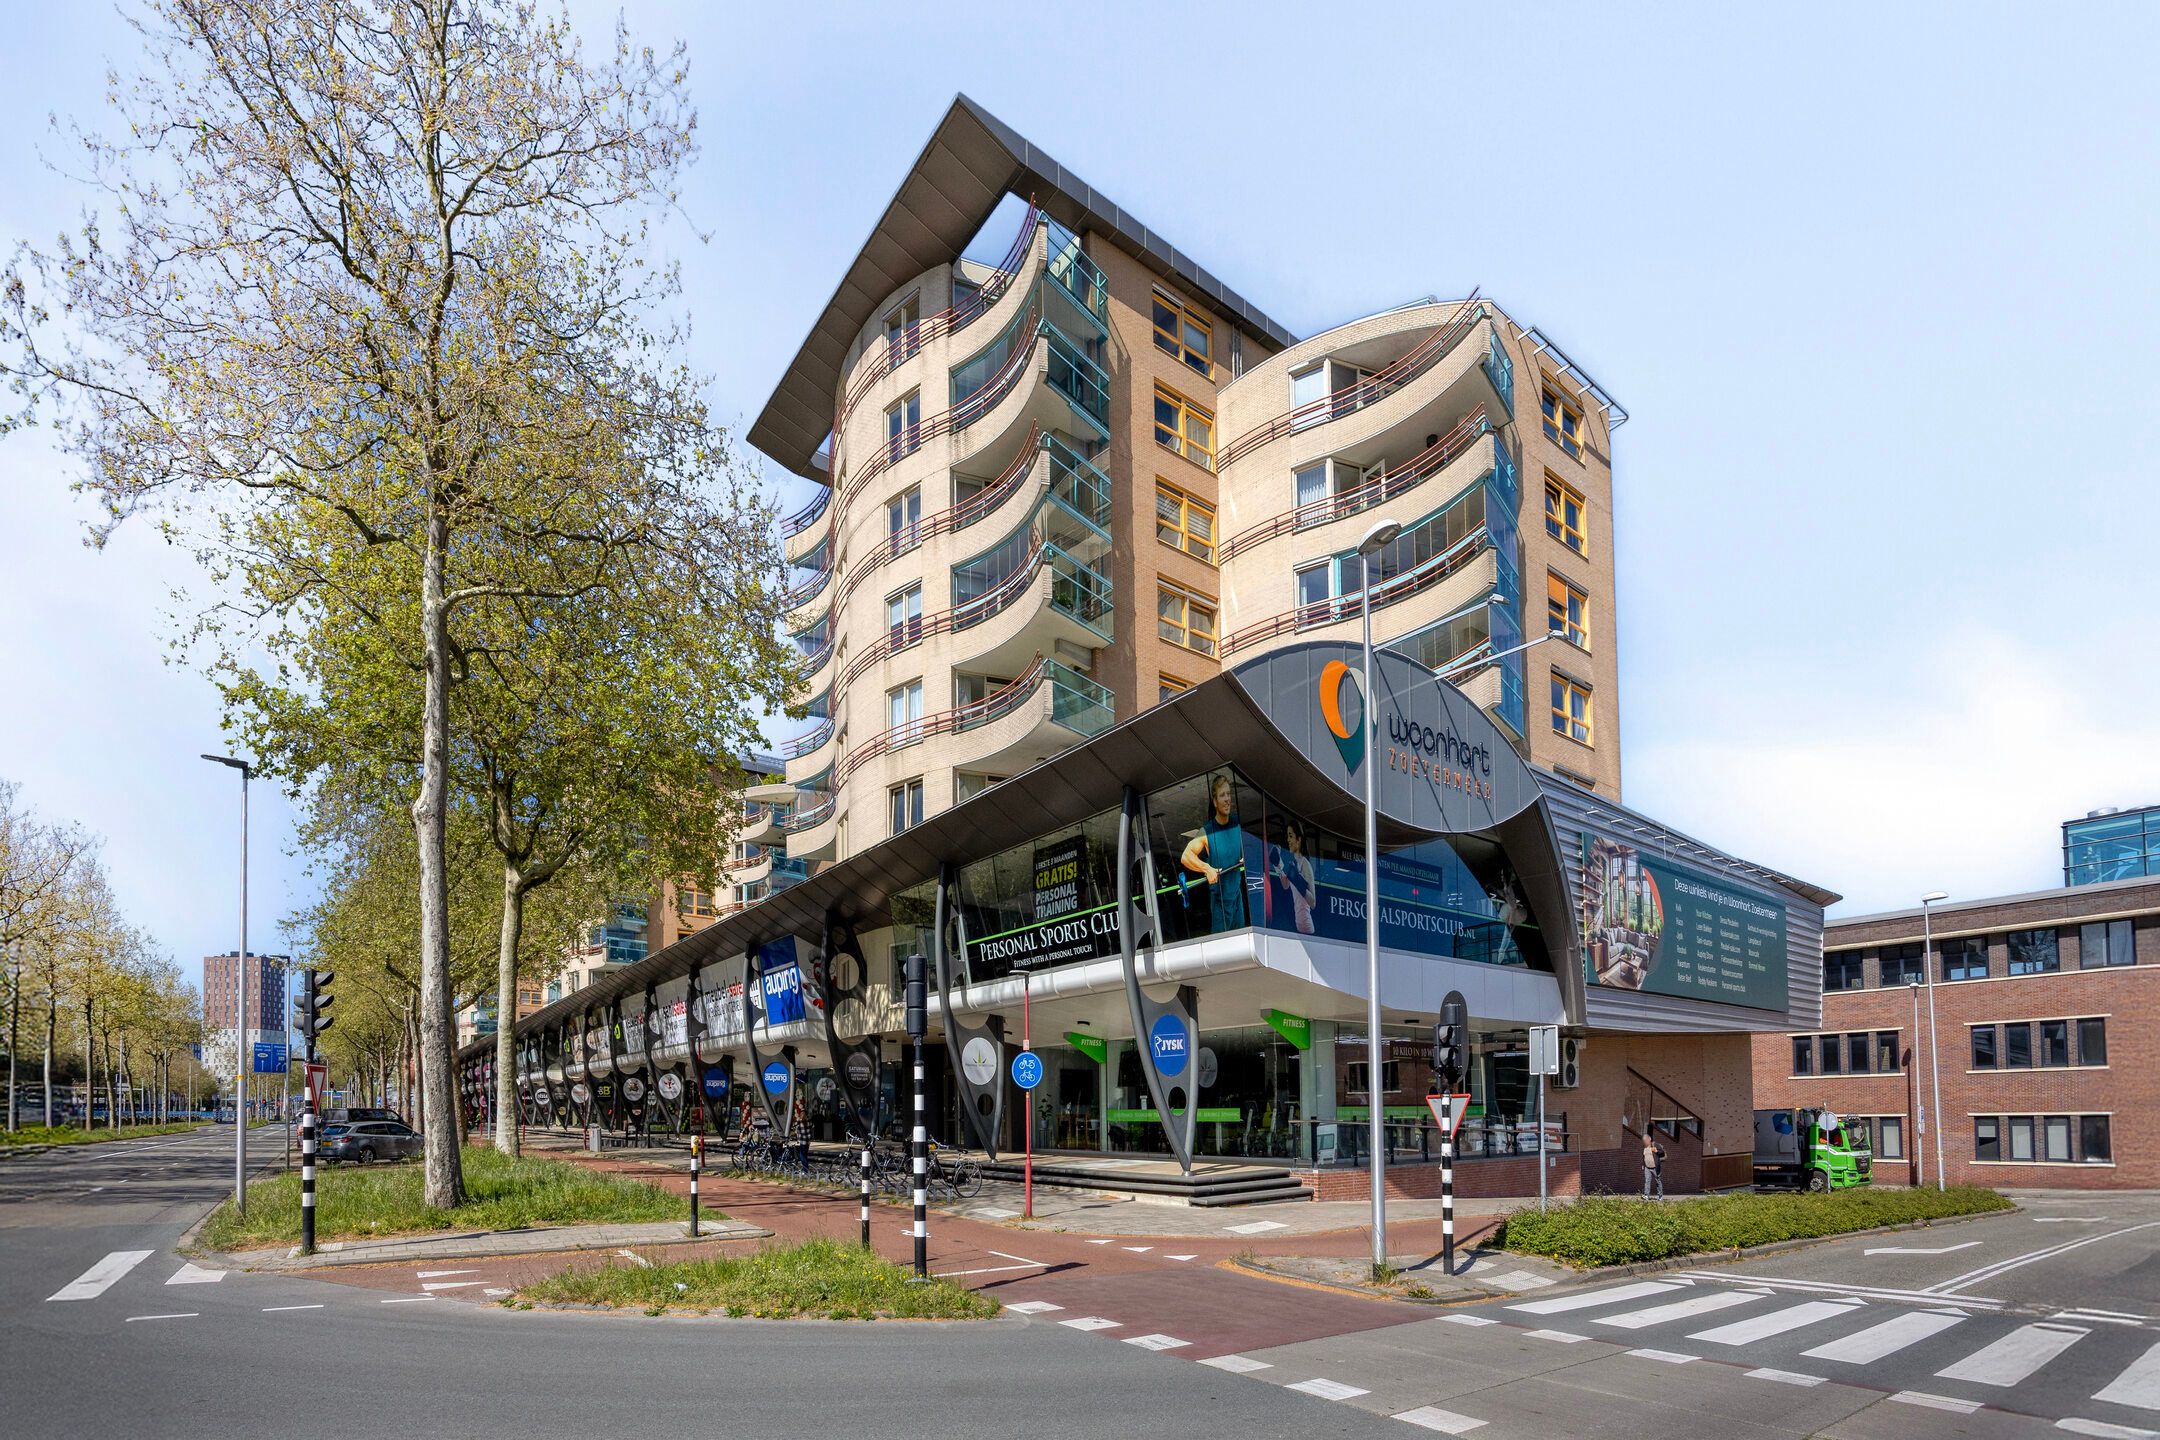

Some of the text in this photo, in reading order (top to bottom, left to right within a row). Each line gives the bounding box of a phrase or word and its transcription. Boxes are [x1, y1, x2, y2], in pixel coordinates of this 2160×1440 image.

[1389, 747, 1490, 800] ZOETERMEER
[1036, 861, 1077, 889] GRATIS!
[1036, 882, 1077, 906] PERSONAL
[1675, 879, 1688, 893] Deze
[1036, 896, 1077, 919] TRAINING
[1330, 896, 1476, 940] PERSOALSPORTSCLUB.NL
[979, 911, 1120, 962] PERSONAL SPORTS CLU
[1049, 949, 1073, 961] PERSONAL
[1073, 944, 1092, 956] TOUCH
[766, 967, 799, 998] auping
[1283, 1018, 1305, 1029] FITNESS
[1081, 1038, 1102, 1048] FITNESS
[1162, 1039, 1184, 1051] JYSK
[706, 1080, 726, 1089] auping
[764, 1073, 788, 1084] auping
